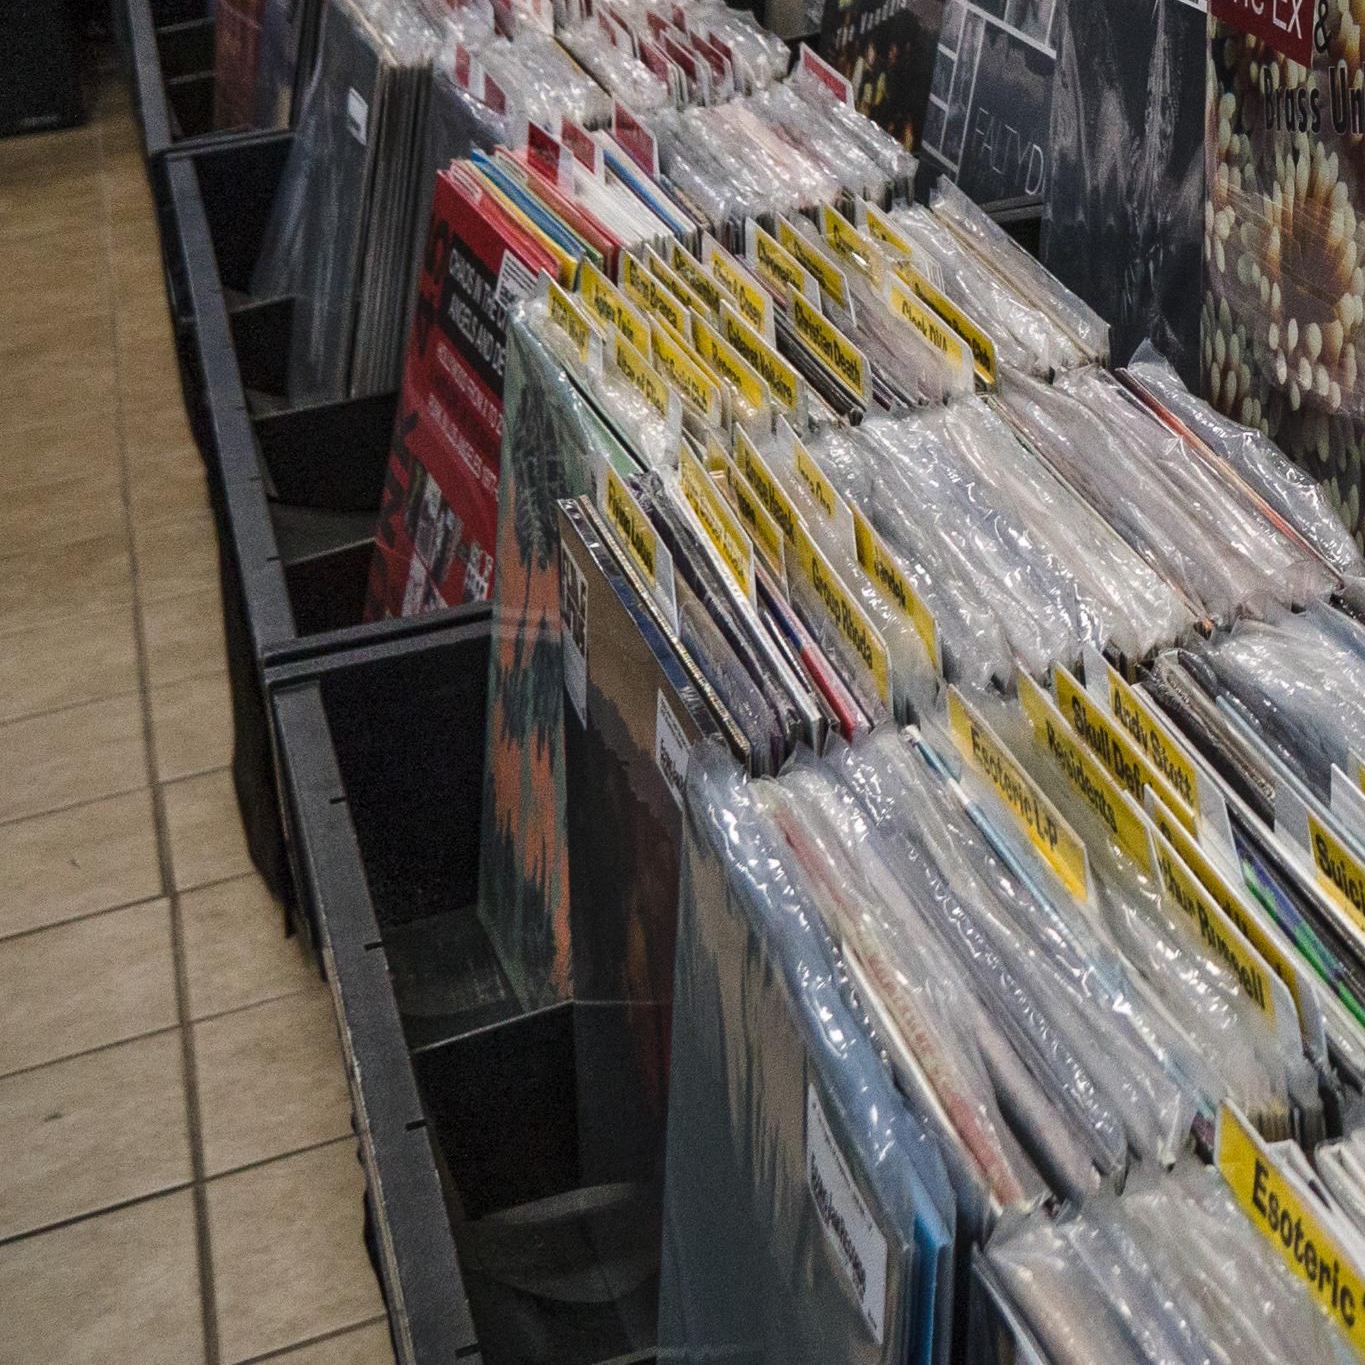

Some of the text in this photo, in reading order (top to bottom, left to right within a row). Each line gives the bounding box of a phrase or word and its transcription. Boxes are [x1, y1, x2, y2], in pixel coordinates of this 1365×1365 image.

[1261, 65, 1322, 135] Brass
[759, 348, 792, 408] Voltaire
[794, 297, 861, 392] Christian Death
[811, 555, 840, 627] Group
[840, 595, 873, 672] Rhoda
[969, 720, 1034, 826] Esoteric
[1045, 719, 1118, 836] Residents
[1070, 694, 1112, 769] Skull
[1112, 691, 1192, 809] Andy Stott
[1251, 1155, 1357, 1326] Esoteric
